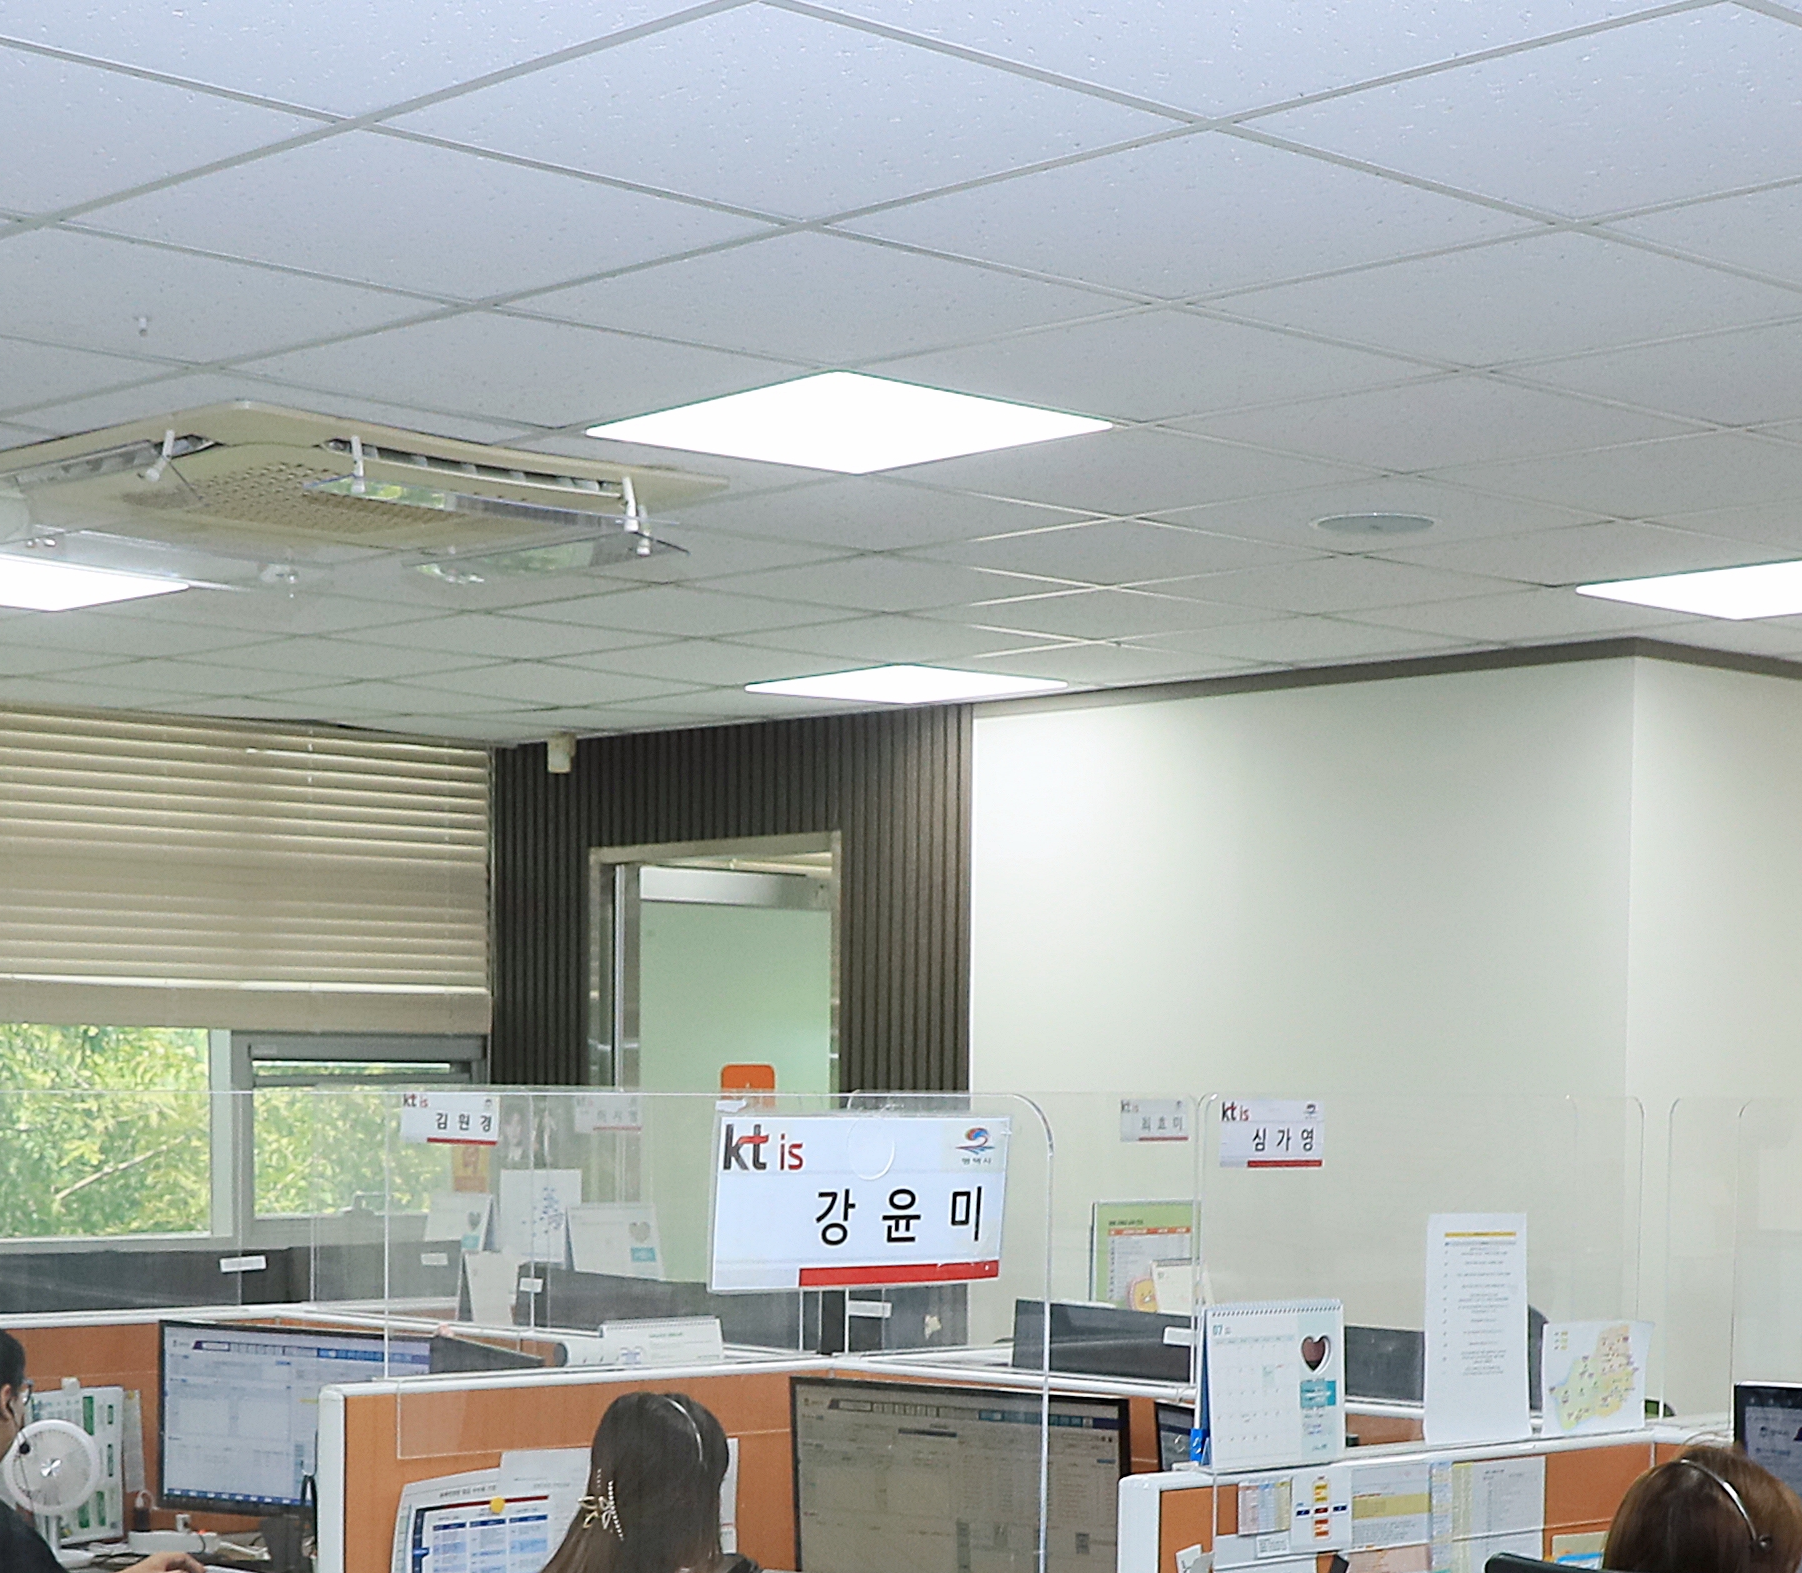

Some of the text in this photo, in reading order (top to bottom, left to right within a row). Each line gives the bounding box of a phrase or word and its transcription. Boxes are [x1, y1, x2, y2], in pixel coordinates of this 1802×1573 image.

[402, 1094, 417, 1106] kt
[1222, 1102, 1249, 1121] kt is
[723, 1123, 804, 1171] kt is
